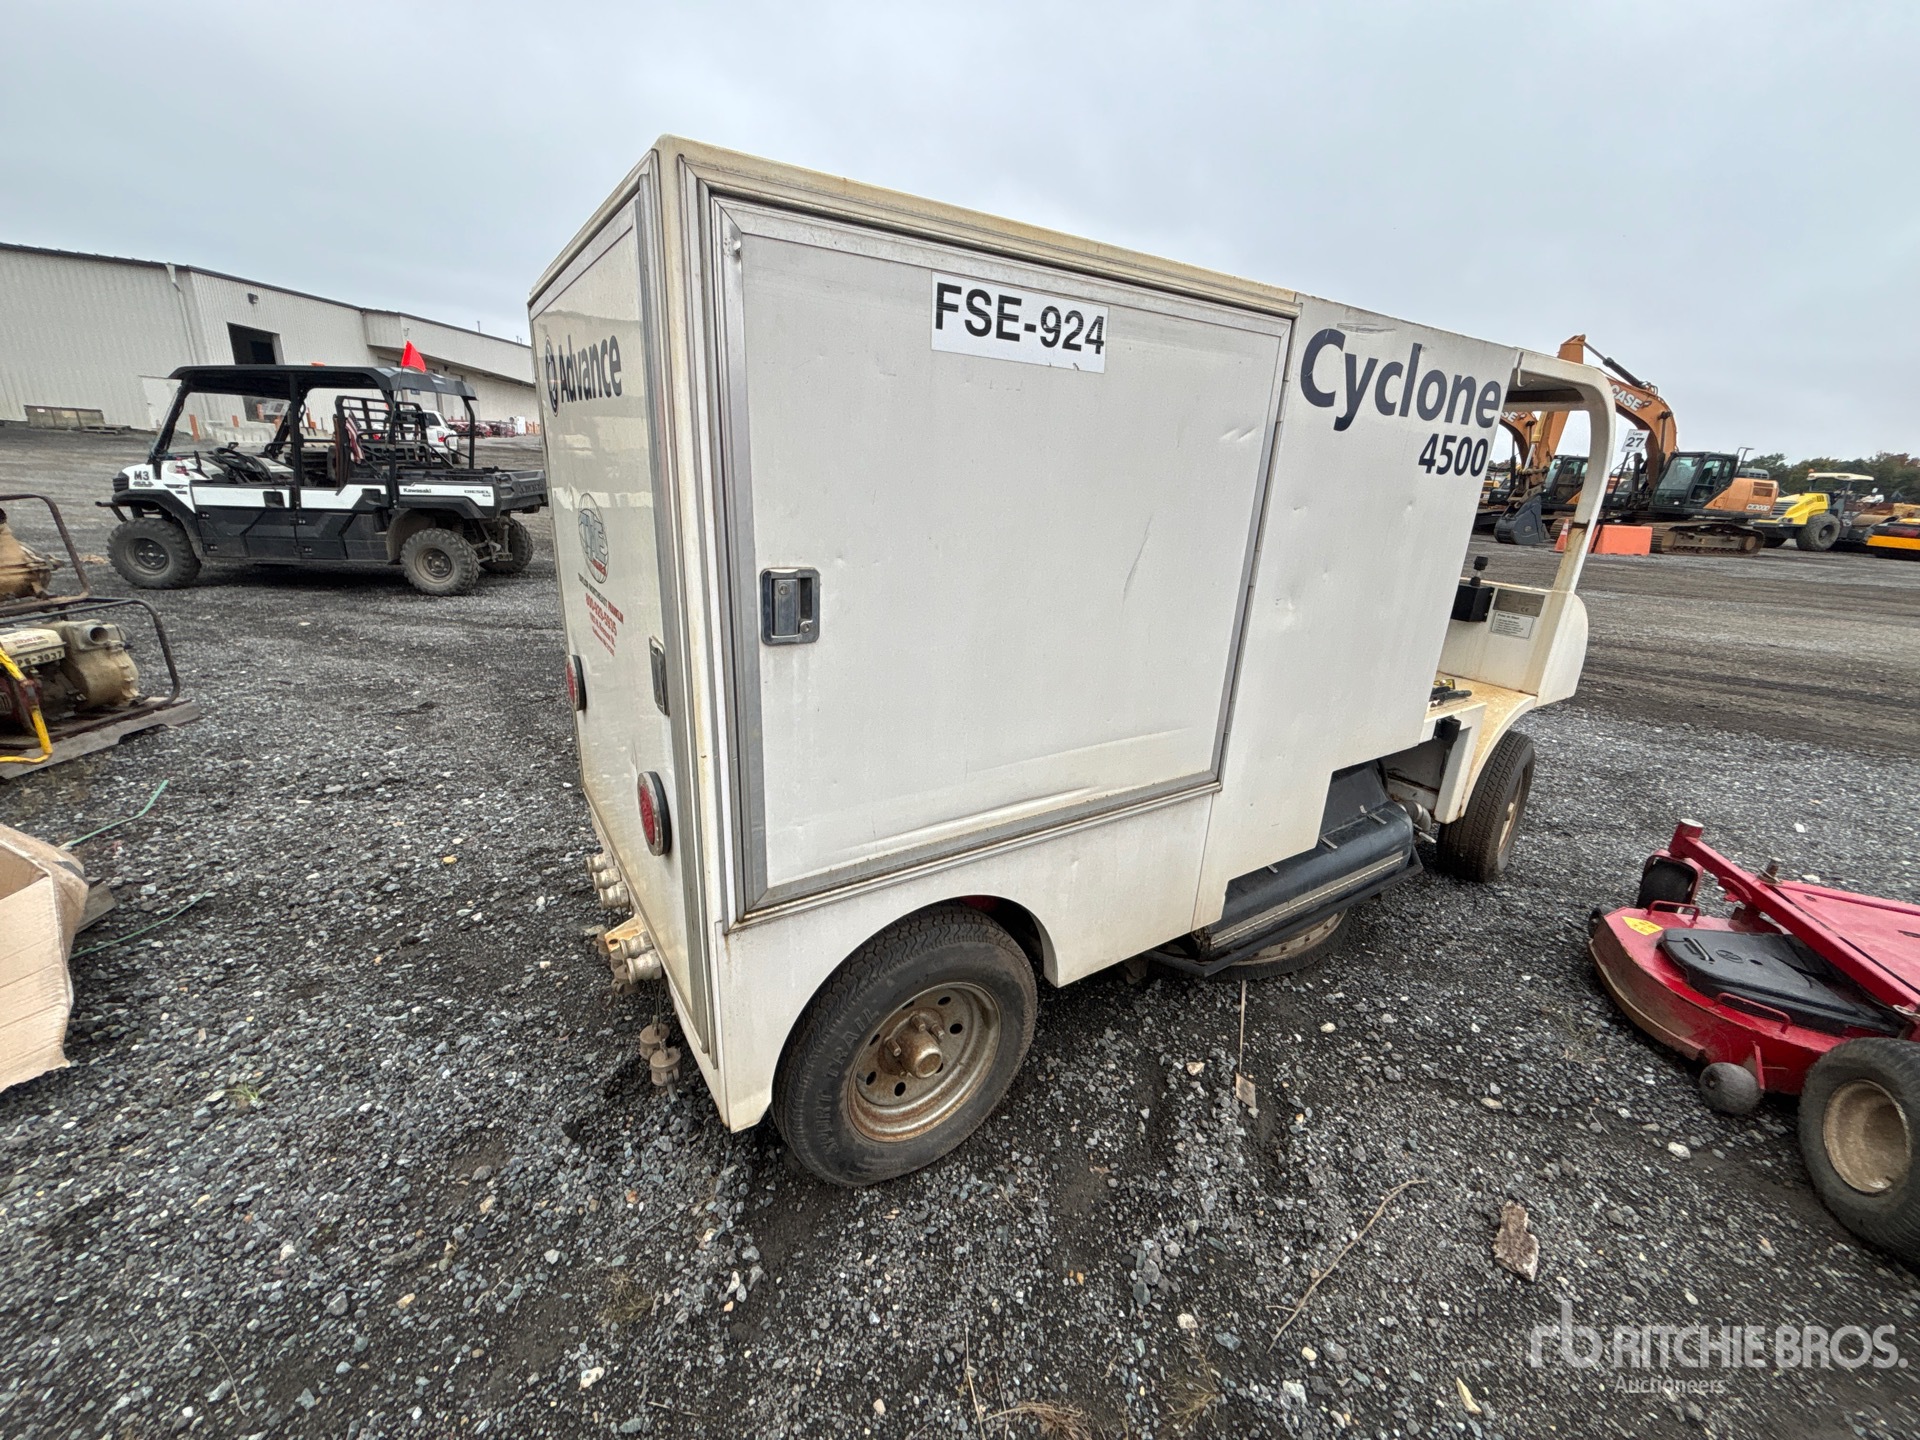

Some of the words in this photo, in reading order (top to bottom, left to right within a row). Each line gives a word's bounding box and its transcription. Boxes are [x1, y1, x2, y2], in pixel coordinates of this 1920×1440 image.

[934, 282, 1106, 355] FSE-924
[559, 334, 623, 403] Advance
[1299, 328, 1502, 432] Cyclone
[1611, 384, 1642, 411] CASE
[1417, 432, 1490, 477] 4500
[1625, 437, 1645, 448] 27
[133, 470, 150, 481] M3
[828, 1008, 878, 1078] TRAIL
